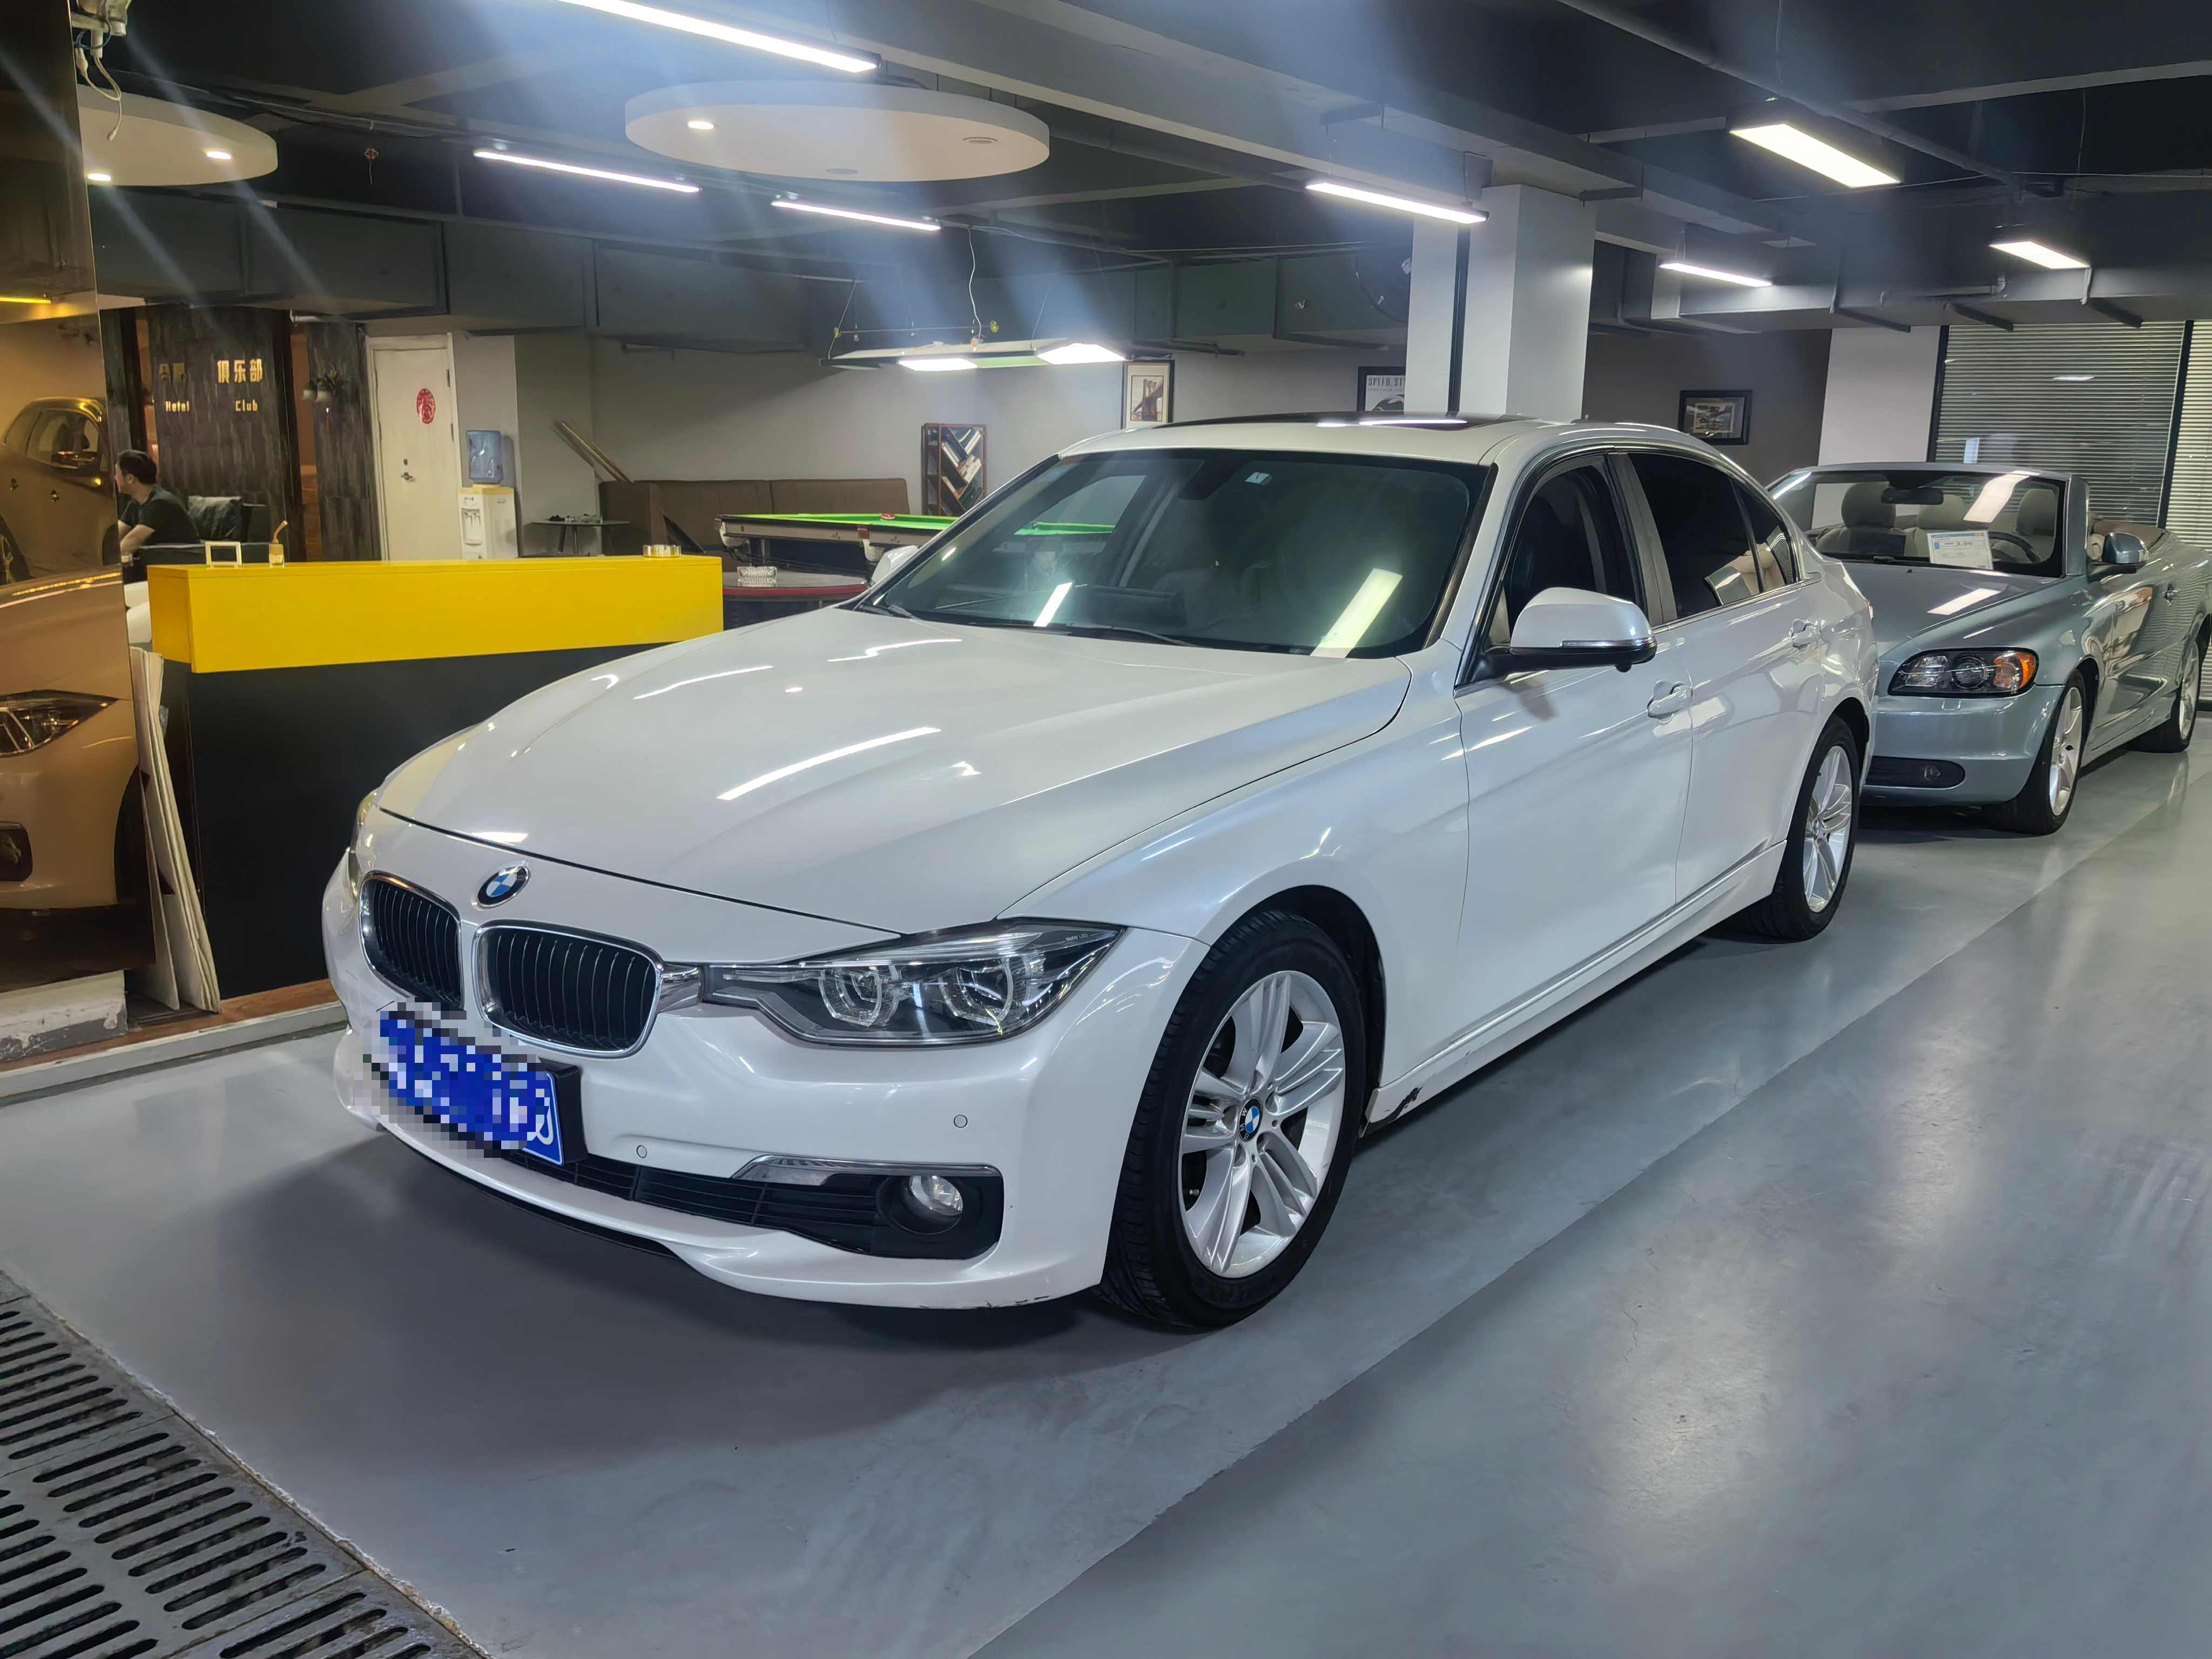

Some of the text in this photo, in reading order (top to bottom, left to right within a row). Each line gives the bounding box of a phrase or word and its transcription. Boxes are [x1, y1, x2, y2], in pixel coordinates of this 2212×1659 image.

[217, 359, 262, 383] 俱乐部
[1394, 377, 1405, 386] ST
[235, 399, 258, 412] Club
